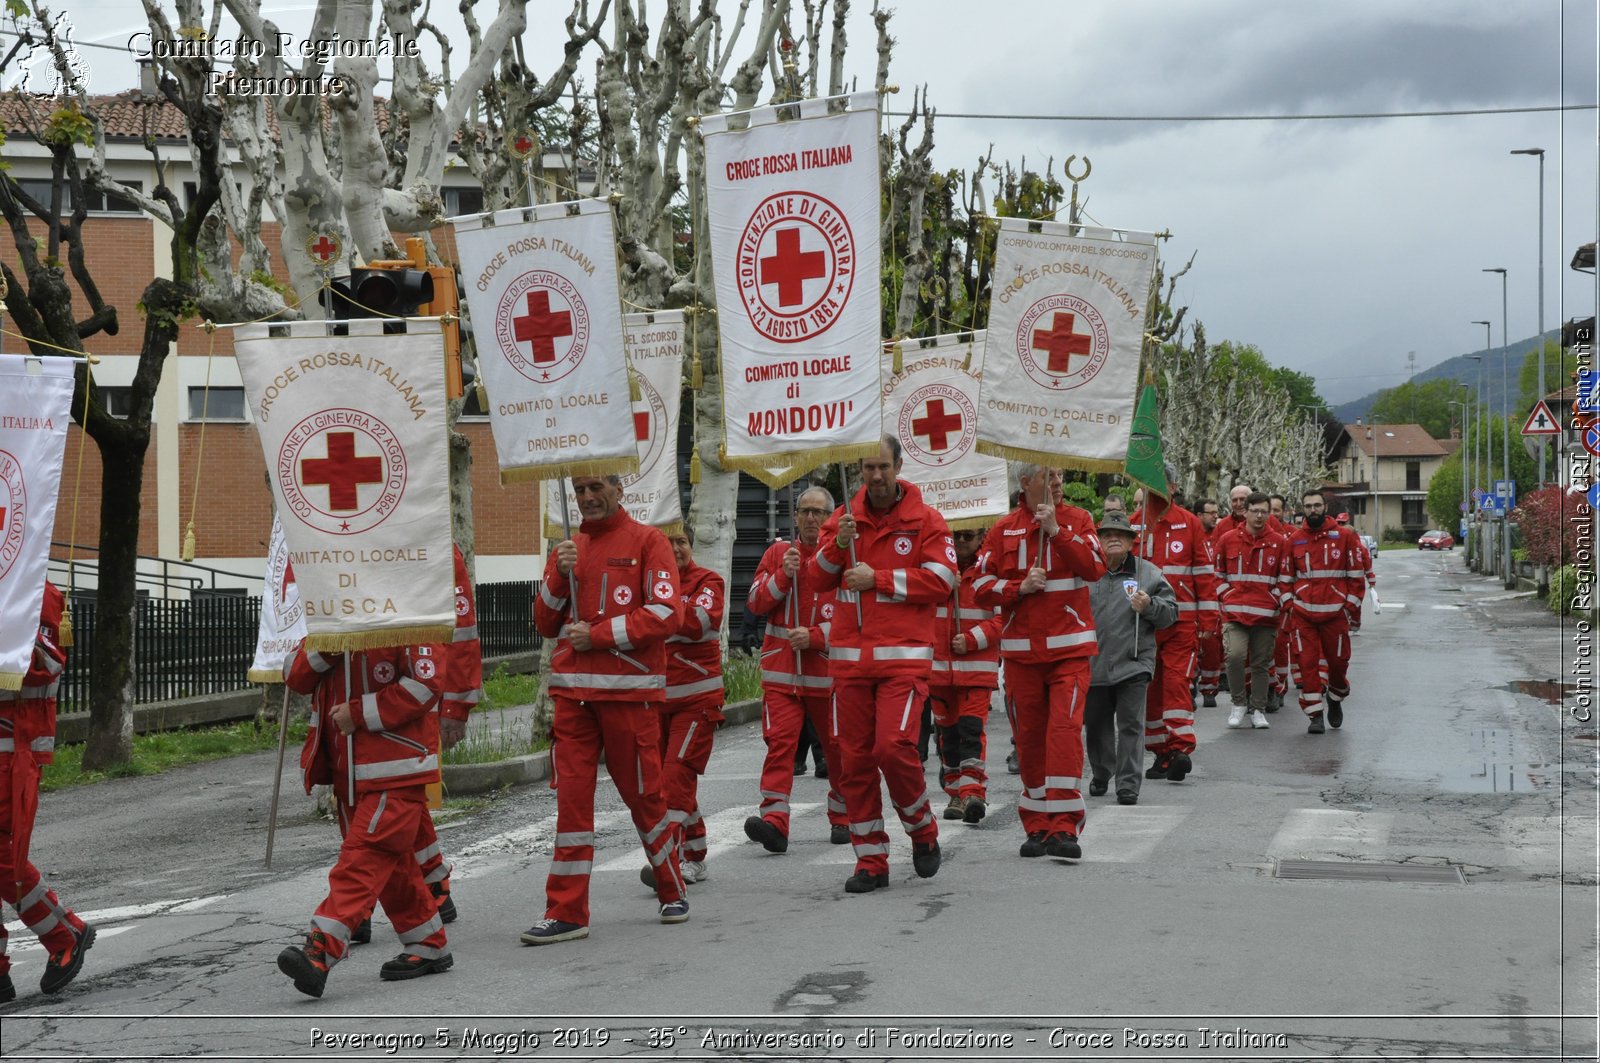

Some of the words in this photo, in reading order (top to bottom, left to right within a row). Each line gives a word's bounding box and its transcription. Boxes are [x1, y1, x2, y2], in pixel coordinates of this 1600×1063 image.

[726, 158, 760, 181] CROCE
[763, 152, 798, 175] ROSSA
[801, 144, 852, 170] ITALIANA
[741, 198, 794, 288] CONVENZIONE
[800, 198, 817, 219] DI
[818, 210, 850, 276] GINEVRA
[1003, 238, 1033, 249] CORPO
[1033, 240, 1080, 255] VOLONTARI
[1081, 246, 1098, 256] DEL
[1100, 248, 1148, 261] SOCCORSO
[476, 251, 508, 292] CROCE
[507, 237, 547, 258] ROSSA
[552, 238, 596, 278] ITALIANA
[510, 284, 520, 297] DI
[518, 274, 560, 290] GINEVRA
[559, 282, 573, 296] 22
[999, 268, 1040, 304] CRCE
[1042, 262, 1090, 278] ROSSA
[1092, 269, 1140, 320] ITALIANA
[1037, 302, 1048, 312] DI
[1048, 298, 1088, 314] GINEVRA
[570, 294, 587, 342] AGOSTO
[752, 306, 767, 327] 22
[766, 317, 808, 338] AGOSTO
[810, 298, 839, 328] 1864
[1086, 310, 1100, 323] 22
[498, 294, 526, 370] CONVENZIONE
[1018, 308, 1038, 373] CONVENZIONE
[1094, 322, 1108, 363] AGOSTO
[568, 343, 584, 365] 1864
[745, 361, 798, 383] COMITATO
[804, 356, 852, 376] LOCALE
[905, 358, 948, 376] ROSSA
[1080, 364, 1098, 380] 1864
[260, 366, 300, 423] CROCE
[300, 352, 364, 374] ROSSA
[366, 356, 427, 422] ITALIANA
[786, 383, 800, 399] di
[920, 387, 953, 399] GINEVRA
[954, 392, 964, 401] 22
[500, 398, 554, 416] COMITATO
[560, 392, 609, 408] LOCALE
[910, 394, 920, 404] DI
[314, 412, 370, 431] GINEVRA
[546, 417, 556, 428] DI
[748, 400, 852, 437] MONDOVI'
[962, 400, 976, 432] AGOSTO
[987, 400, 1048, 418] COMITATO
[1054, 408, 1104, 424] LOCALE
[1108, 414, 1121, 426] DI
[300, 422, 314, 436] DI
[370, 424, 387, 440] 22
[900, 400, 920, 457] CONVENZIONE
[1028, 422, 1070, 438] BRA
[528, 433, 590, 452] DRONERO
[958, 432, 974, 452] 1864
[382, 438, 404, 490] AGOSTO
[280, 432, 312, 519] CONVENZIONE
[948, 478, 988, 490] LOCALE
[376, 490, 398, 516] 1864
[620, 492, 655, 504] OCALE
[936, 498, 988, 512] PIEMONTE
[2, 502, 24, 562] AGOSTO
[290, 551, 355, 564] OMITATO
[360, 548, 428, 563] LOCALE
[338, 573, 357, 588] DI
[306, 598, 398, 616] BUSCA
